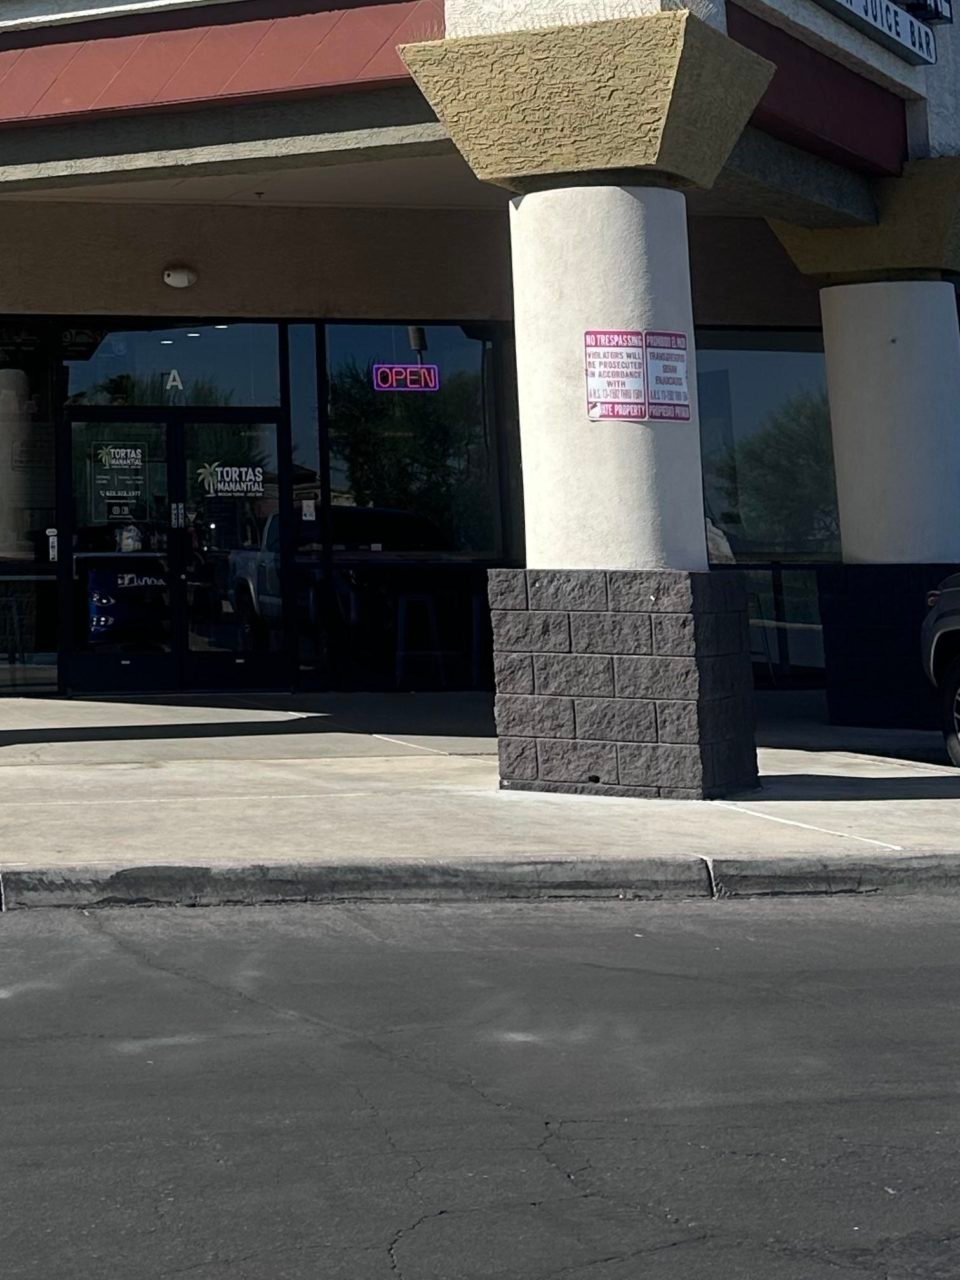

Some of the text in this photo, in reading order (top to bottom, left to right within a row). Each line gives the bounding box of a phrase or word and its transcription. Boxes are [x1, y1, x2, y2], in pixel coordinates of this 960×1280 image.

[909, 20, 933, 59] BAR
[586, 334, 596, 346] NO
[625, 352, 642, 360] WILL
[165, 369, 183, 391] A
[376, 367, 436, 388] OPEN
[606, 380, 626, 388] WITH
[110, 448, 142, 459] TORTAS
[215, 466, 263, 482] TORTAS
